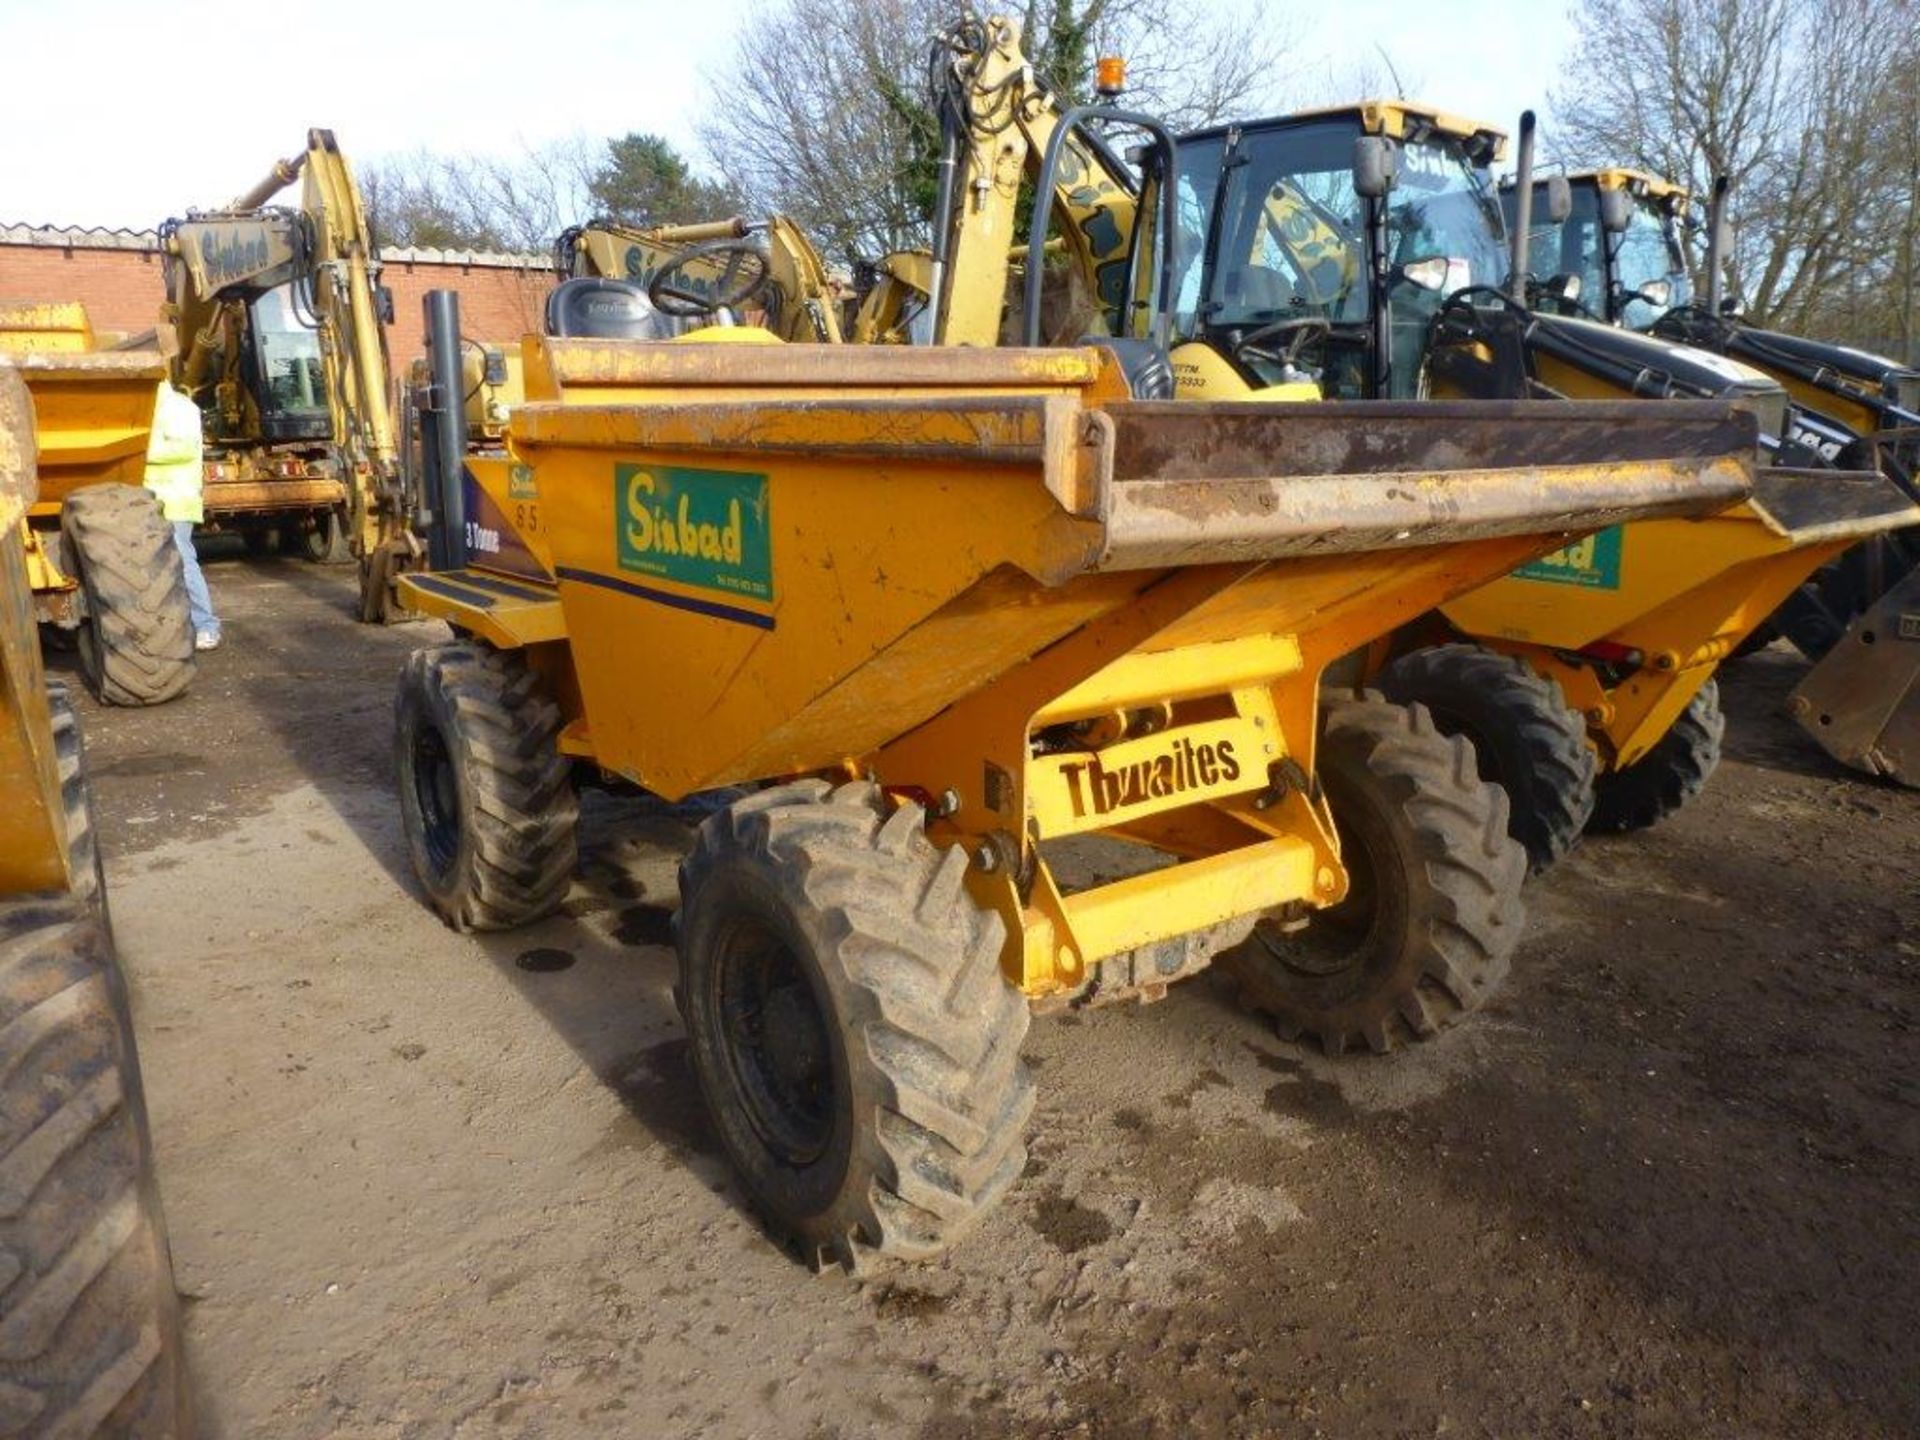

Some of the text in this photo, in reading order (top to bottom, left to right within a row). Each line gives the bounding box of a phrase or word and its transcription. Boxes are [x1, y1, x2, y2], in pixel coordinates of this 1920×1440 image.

[465, 522, 500, 553] 3 Tonne
[627, 471, 741, 565] Sinbad
[1059, 737, 1240, 818] Thwaites
